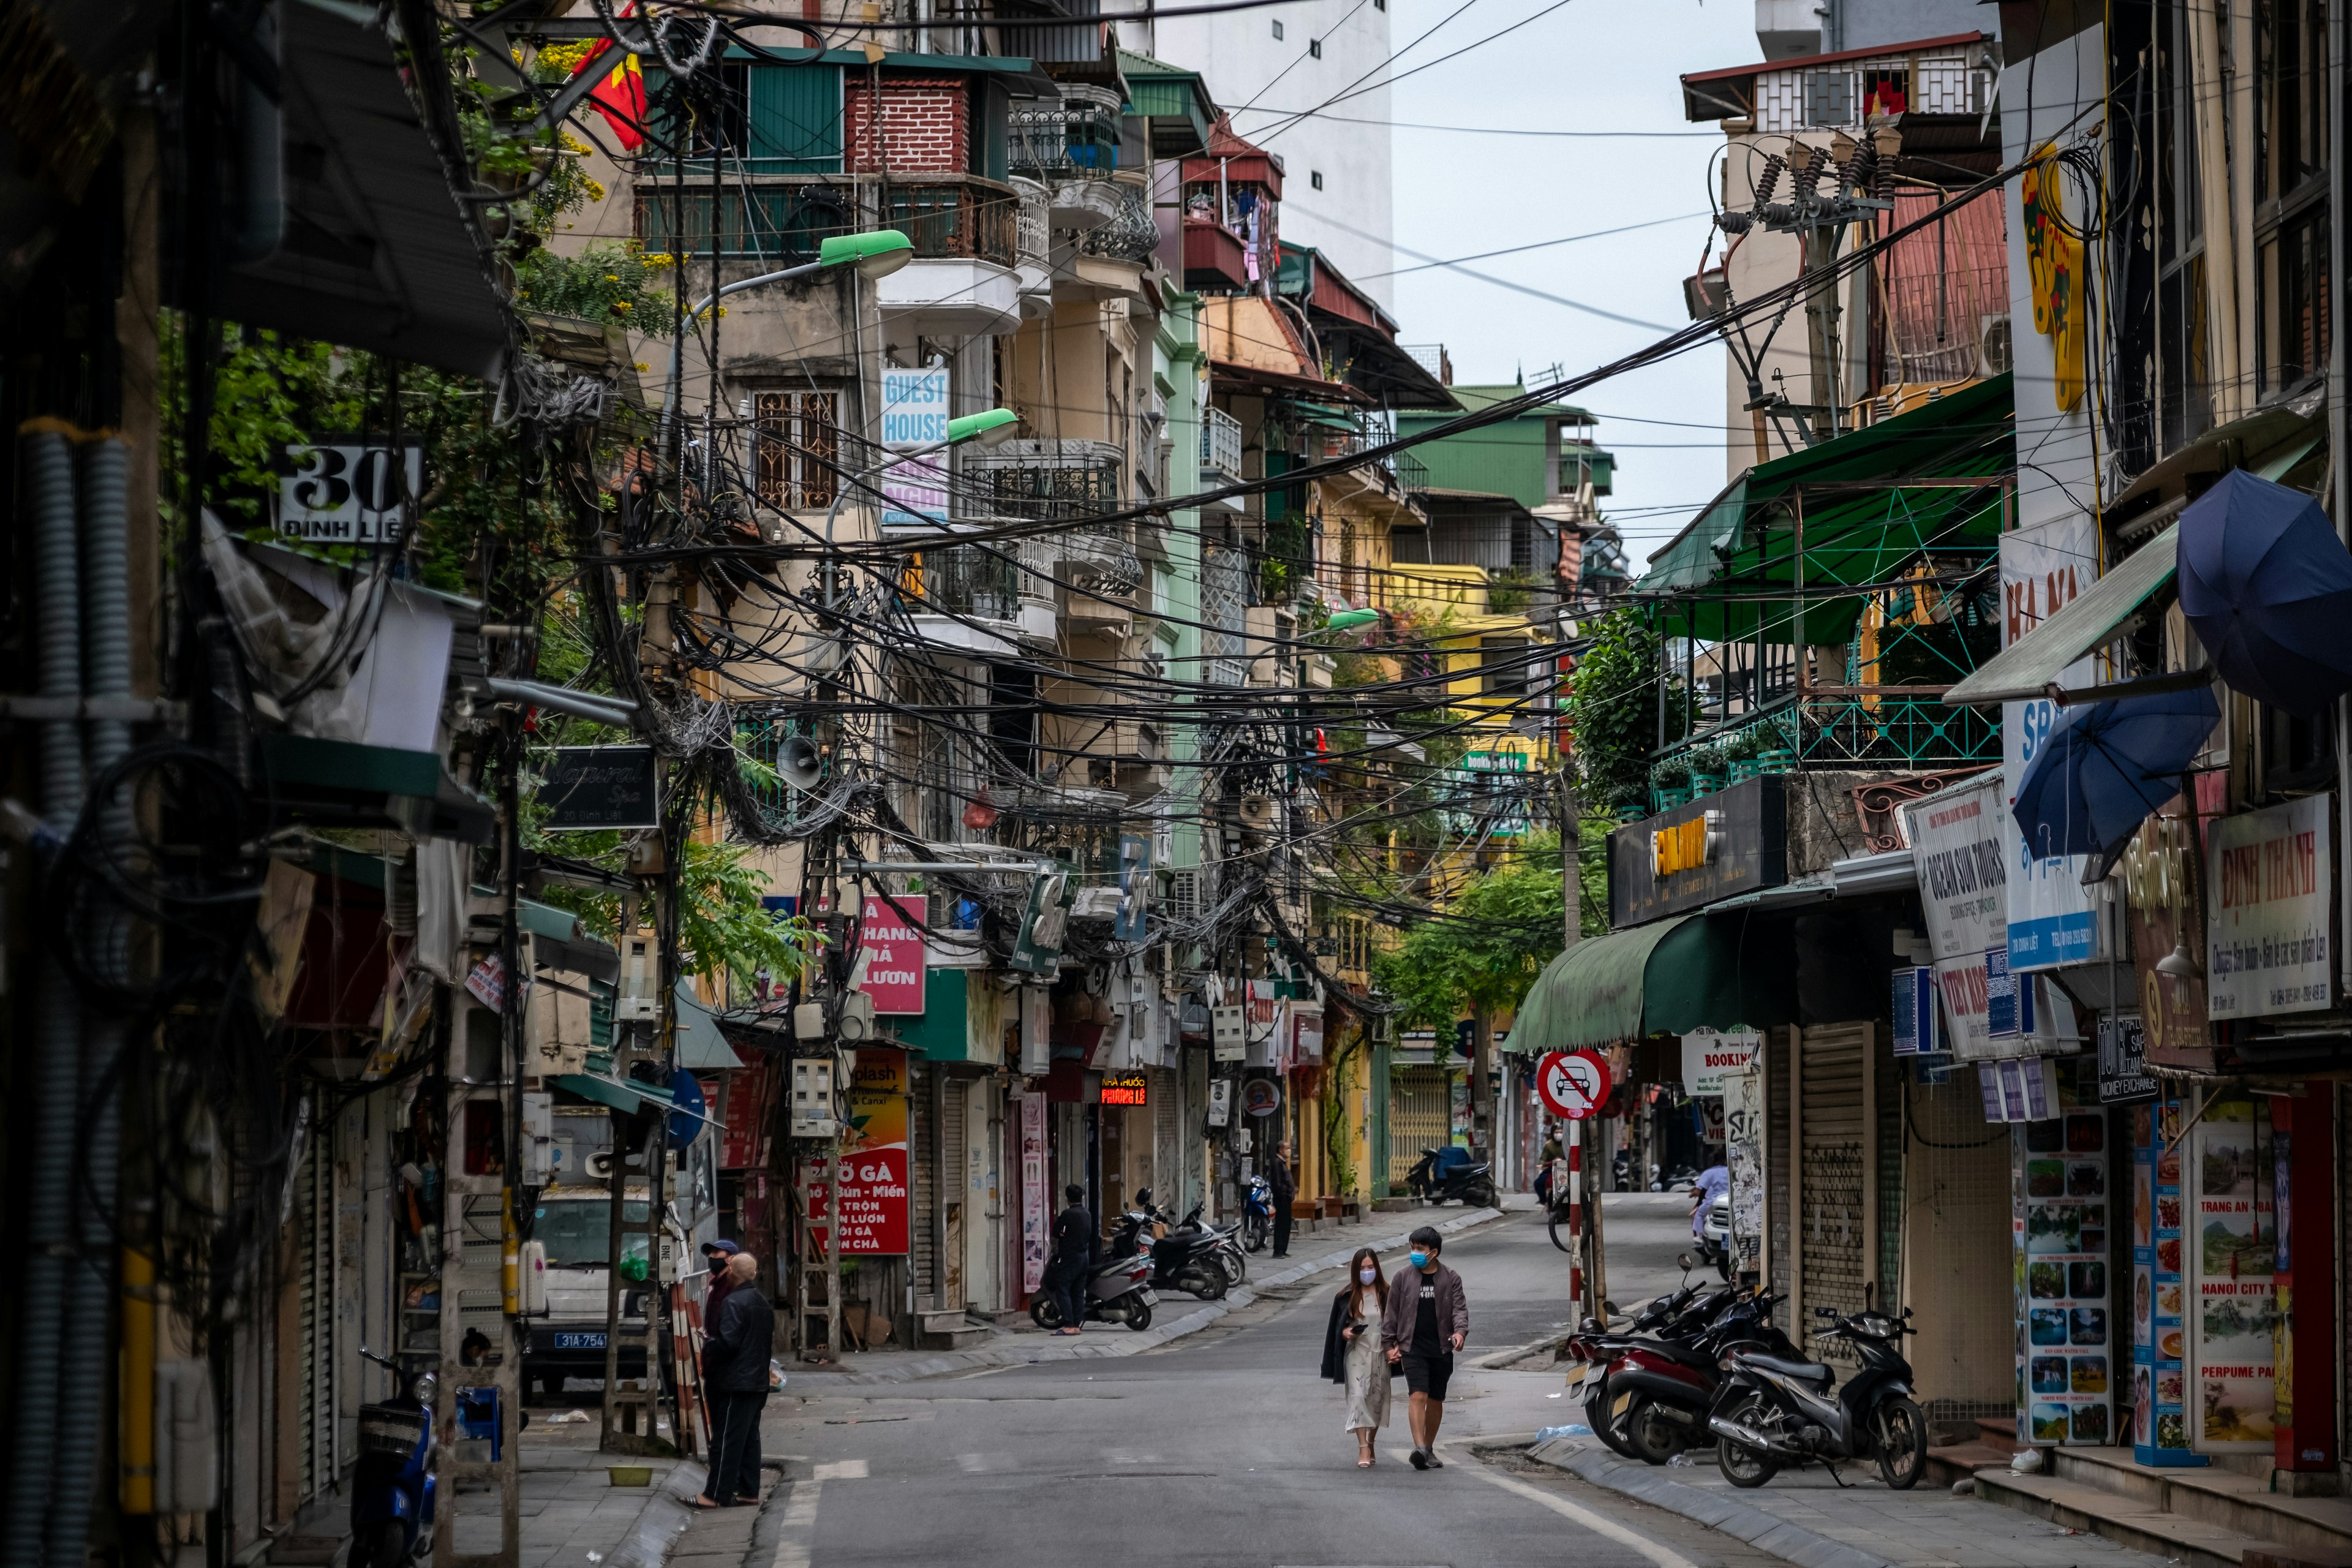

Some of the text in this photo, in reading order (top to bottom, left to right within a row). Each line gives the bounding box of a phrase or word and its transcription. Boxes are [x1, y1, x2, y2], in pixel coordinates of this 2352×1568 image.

[885, 375, 945, 404] GUEST
[884, 413, 946, 442] HOUSE
[293, 448, 405, 512] 30
[283, 520, 349, 537] ĐINH
[2023, 701, 2063, 761] SP
[547, 755, 645, 784] Natural
[607, 785, 641, 808] Spa
[564, 811, 575, 821] 20
[1928, 850, 1959, 901] OCEAN
[1954, 845, 1978, 895] SUN
[1972, 837, 2006, 891] TOURS
[2223, 815, 2315, 925] ĐỊNH THÀNH
[2316, 929, 2326, 962] Len
[2146, 970, 2163, 1048] 9
[2101, 1077, 2157, 1098] MONEY EXCHANGE
[861, 1096, 886, 1105] Canxi
[859, 1161, 894, 1183] GÀ
[872, 1184, 905, 1198] Miến
[2201, 1202, 2232, 1213] TRANG
[2235, 1202, 2248, 1212] AN
[854, 1225, 873, 1236] GÀ
[2202, 1284, 2237, 1295] HANOI
[2241, 1284, 2265, 1295] CITY
[2201, 1366, 2254, 1378] PERPUME
